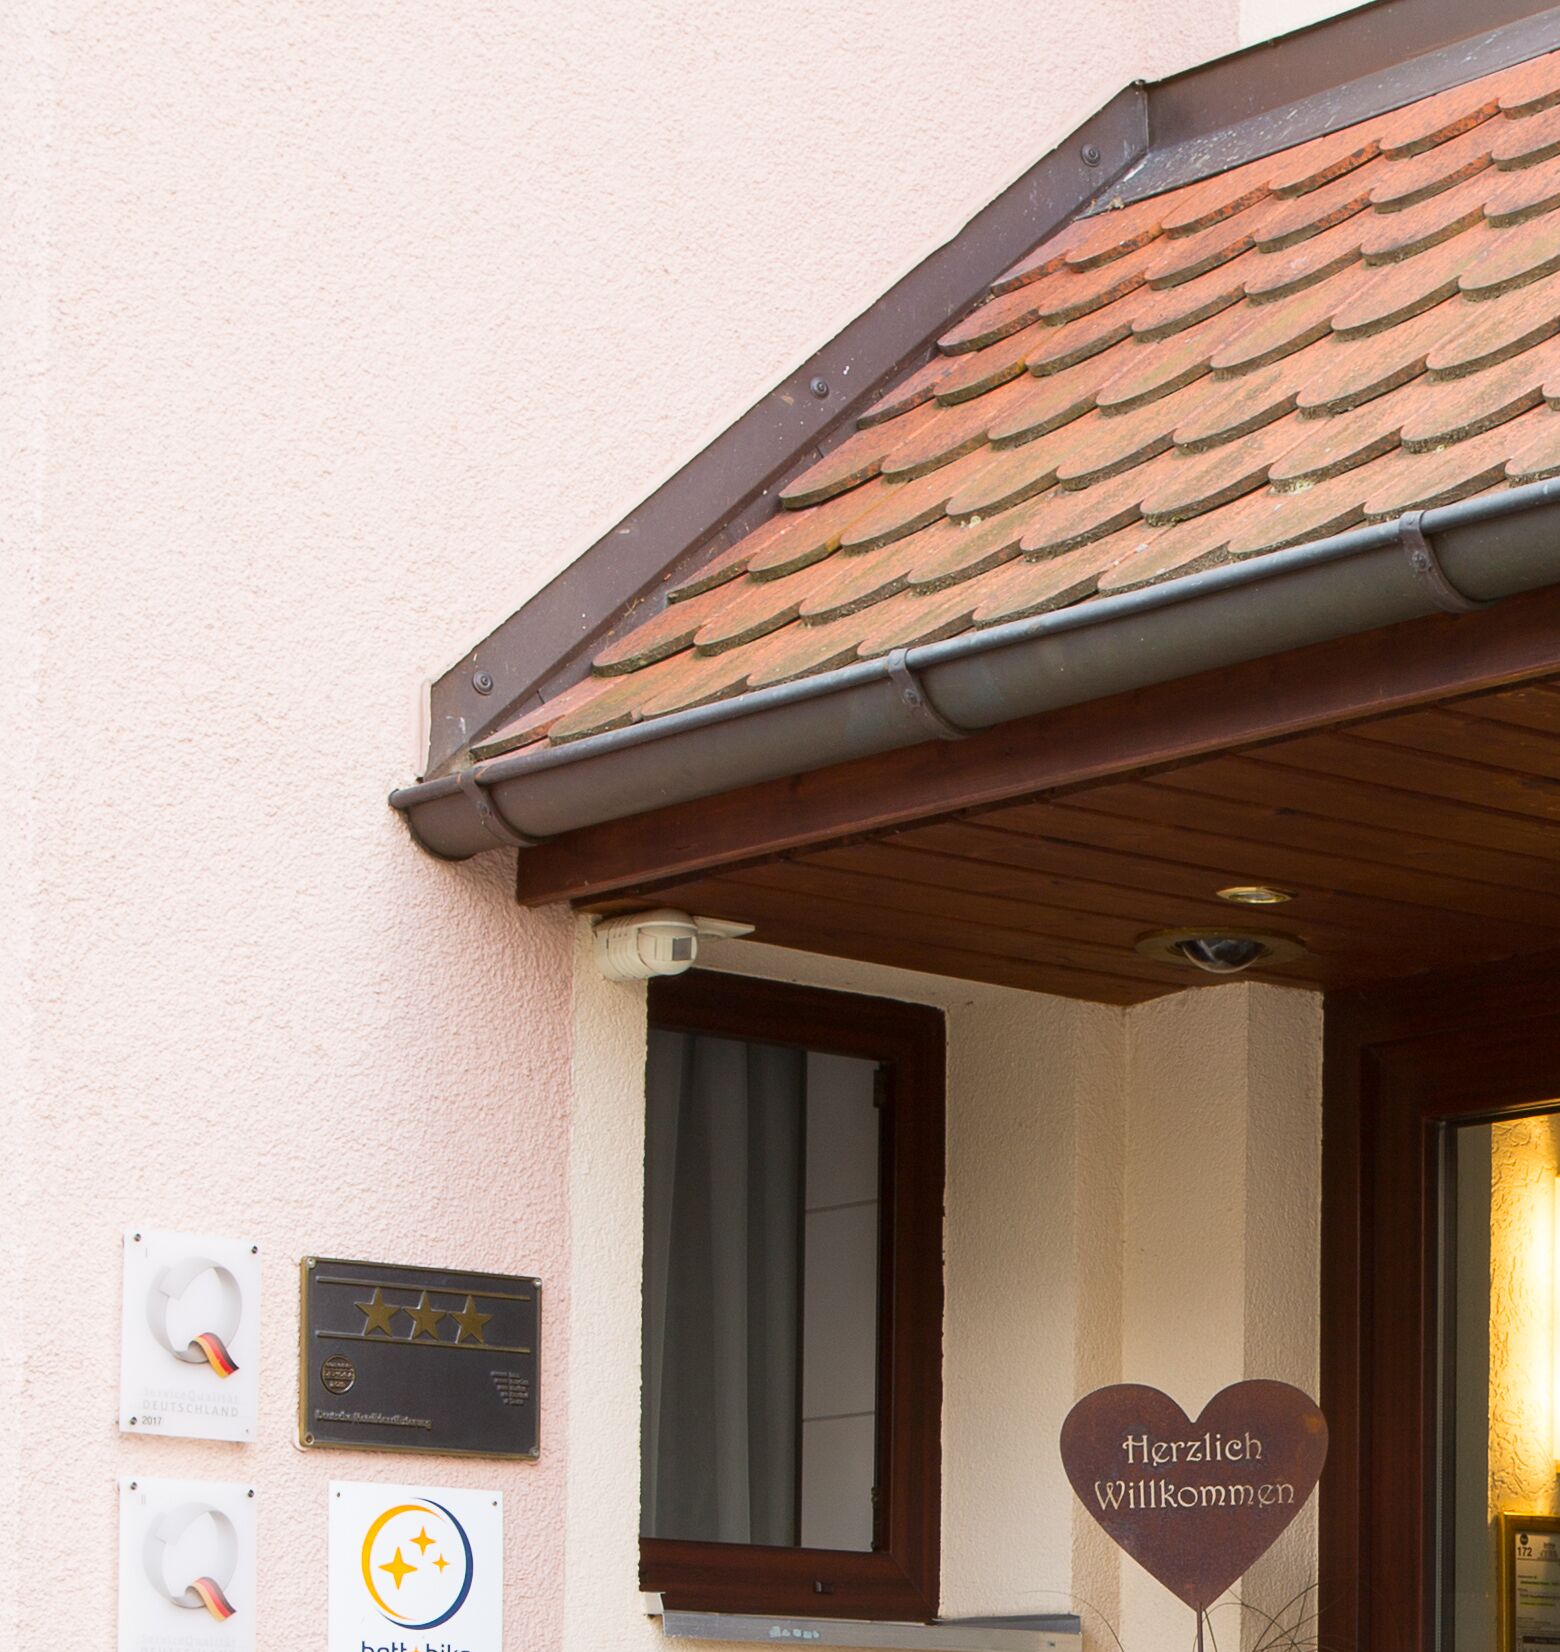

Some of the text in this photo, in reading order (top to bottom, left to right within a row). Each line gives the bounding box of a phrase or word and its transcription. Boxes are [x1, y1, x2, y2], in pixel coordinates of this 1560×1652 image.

[142, 1399, 240, 1418] DEUTSCHLAND
[141, 1415, 163, 1426] 2017
[1122, 1432, 1263, 1467] Herzlich
[1094, 1479, 1295, 1511] Willkommen
[1517, 1546, 1533, 1557] 172
